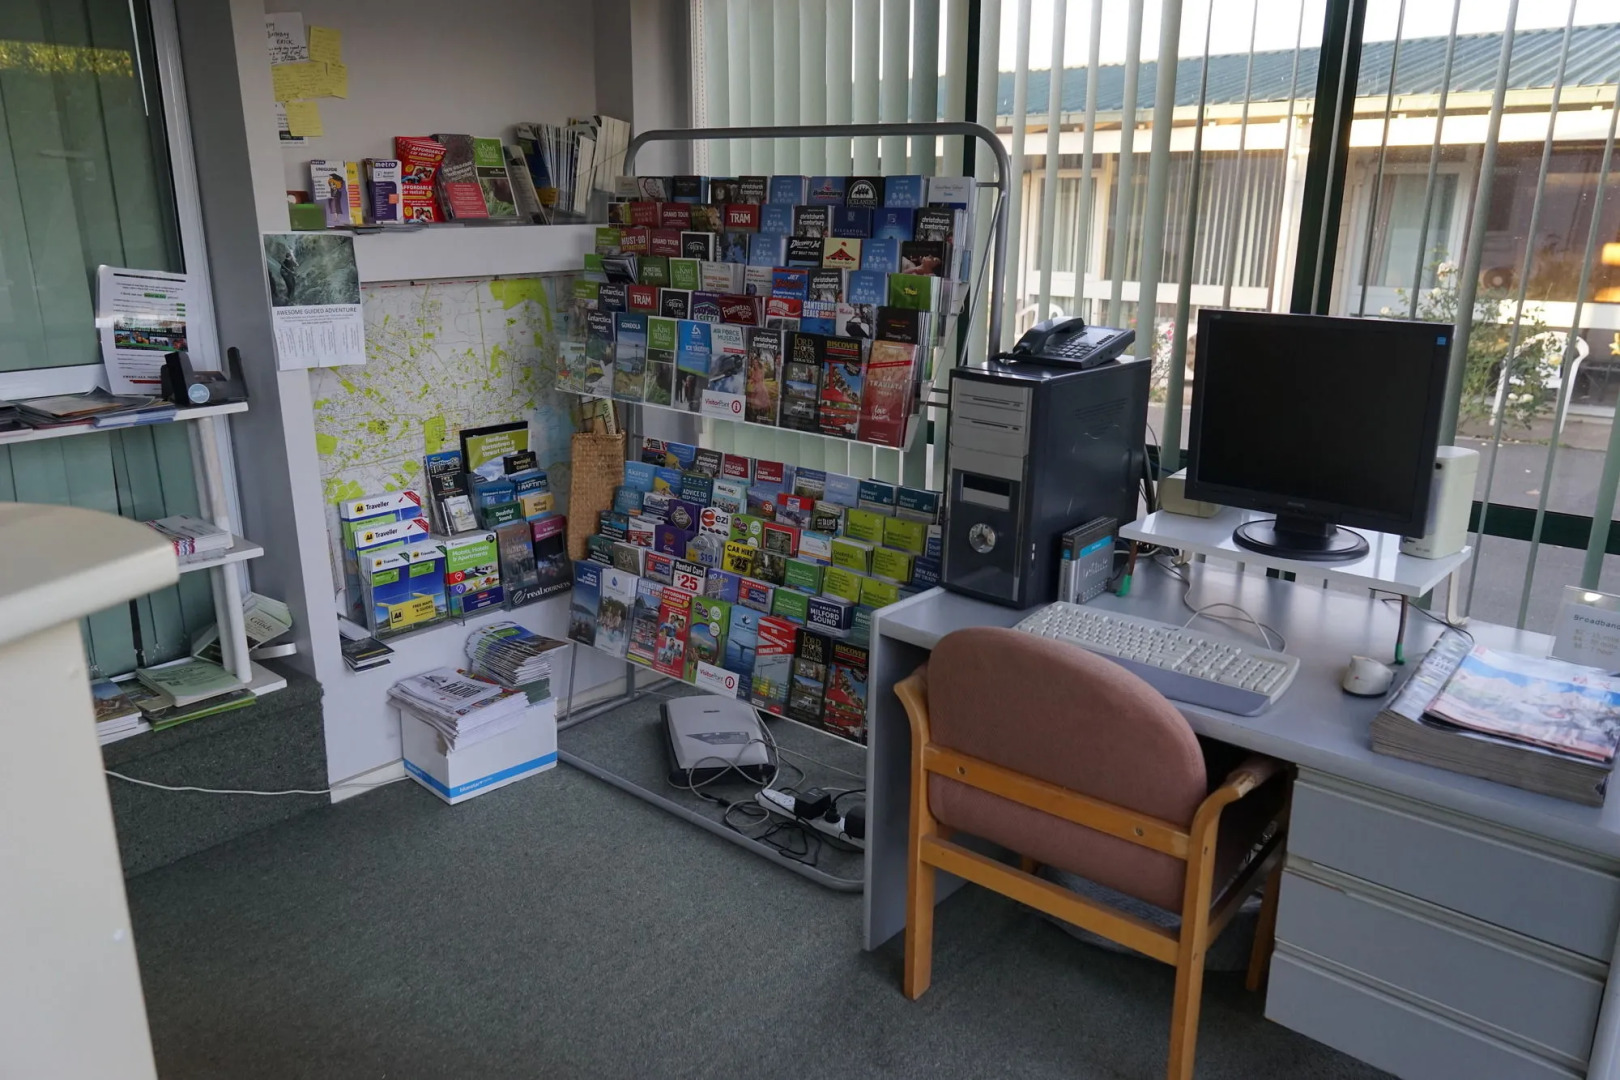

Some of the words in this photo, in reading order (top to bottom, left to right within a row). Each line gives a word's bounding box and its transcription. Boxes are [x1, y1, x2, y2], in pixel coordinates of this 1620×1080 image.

[412, 146, 445, 155] AFFORDABLE
[374, 161, 397, 169] metro
[730, 213, 750, 224] TRAM
[622, 236, 646, 245] MUST-DO
[633, 294, 651, 305] TRAM
[803, 310, 819, 318] DEALS
[621, 322, 641, 330] GONDOLA
[722, 328, 739, 336] FORCE
[718, 334, 740, 342] MUSEUM
[794, 334, 814, 348] LORD
[827, 340, 859, 349] DISCOVER
[870, 380, 903, 390] TRAVIATA
[705, 398, 730, 408] VisitorPoint
[725, 464, 744, 472] MILFORD
[366, 501, 389, 510] Traveller
[496, 508, 514, 517] Doubtful
[498, 514, 512, 522] Sound
[716, 515, 729, 524] ezi
[375, 528, 398, 538] Traveller
[458, 550, 488, 562] Apartments
[741, 548, 754, 556] HIRE
[700, 553, 713, 562] $19
[676, 562, 692, 574] Rental
[694, 566, 704, 576] Cars
[677, 574, 698, 590] $25
[664, 588, 691, 600] AFFORDABLE
[810, 608, 840, 621] MILFORD
[813, 615, 836, 627] SOUND
[803, 632, 822, 647] LORD
[835, 645, 867, 659] DISCOVER
